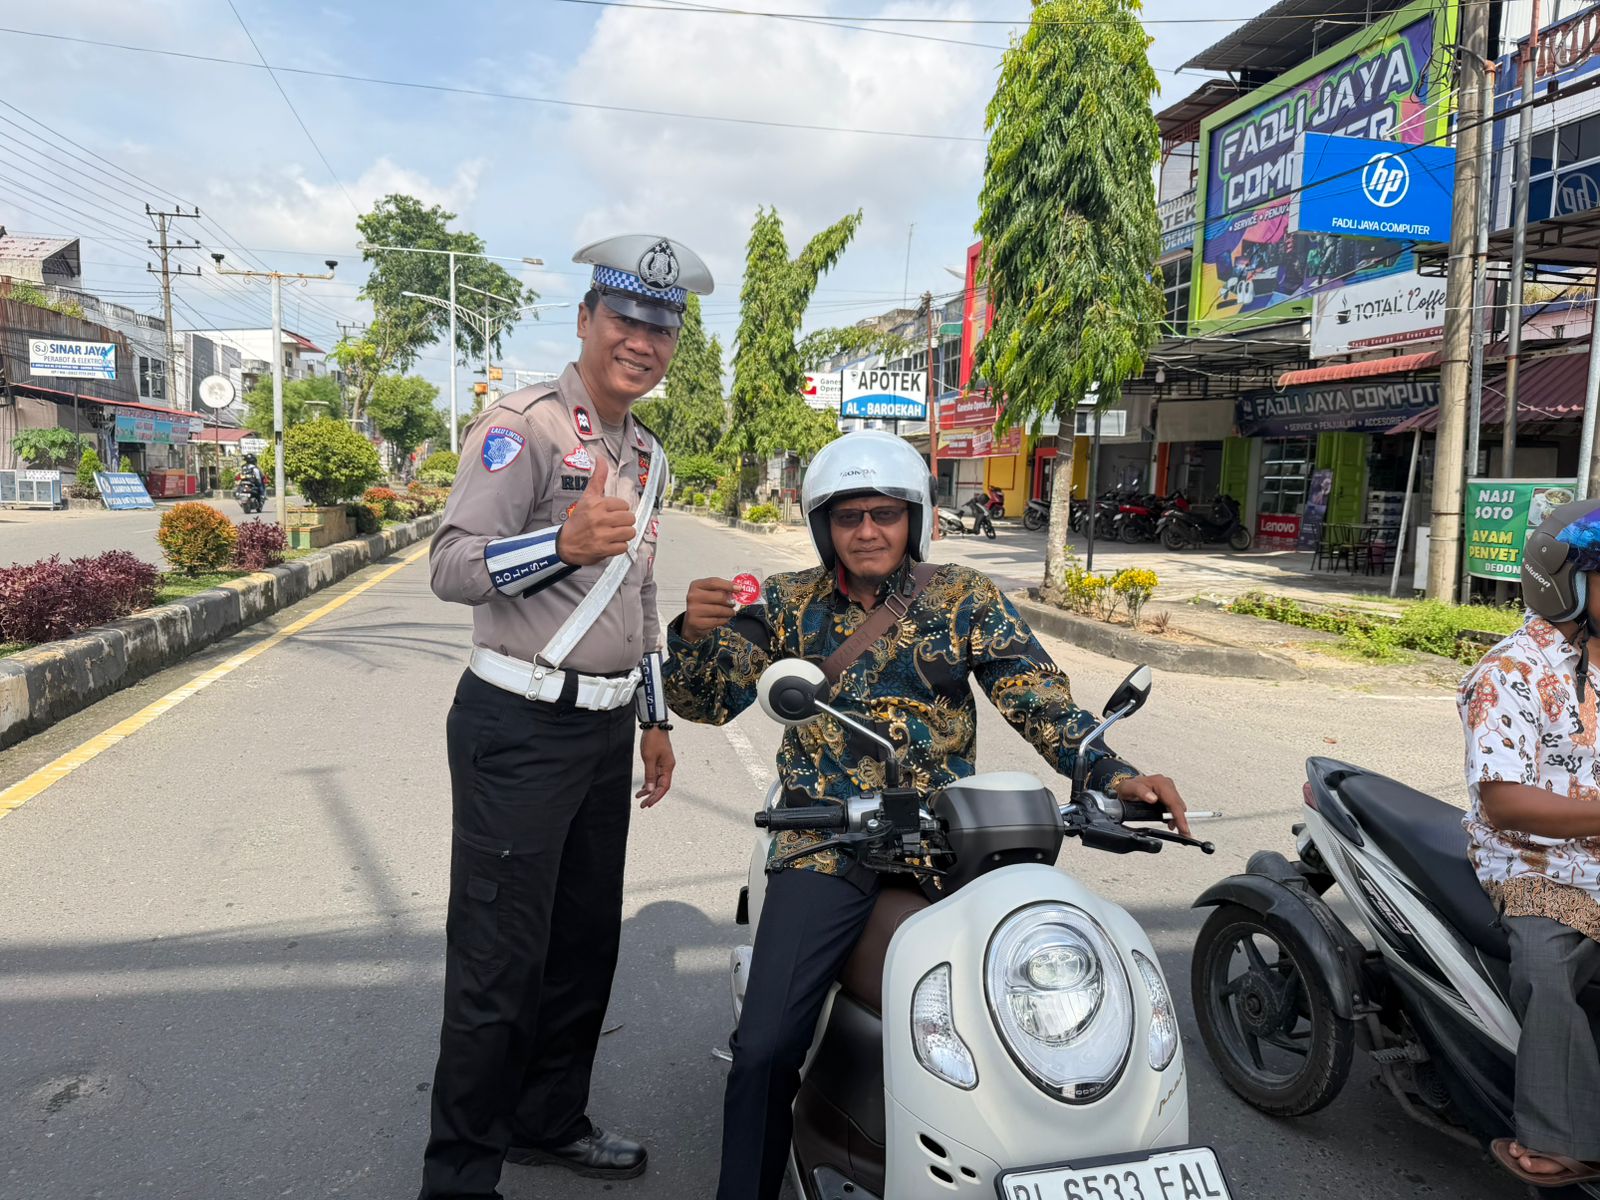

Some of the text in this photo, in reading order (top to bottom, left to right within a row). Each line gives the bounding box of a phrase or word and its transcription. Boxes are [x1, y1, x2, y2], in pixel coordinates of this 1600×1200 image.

[1224, 48, 1410, 168] FADLI JAYA
[1366, 155, 1405, 207] hp
[1233, 213, 1258, 232] SERVICE
[1331, 217, 1430, 235] FADLI JAYA COMPUTER
[1354, 296, 1402, 321] TOTAL
[34, 344, 47, 353] SJ
[49, 343, 108, 357] SINAR JAYA
[43, 355, 71, 364] PERABOT
[858, 371, 922, 392] APOTEK
[1256, 382, 1441, 417] FADLI JAYA COMPUT
[846, 402, 859, 415] AL
[867, 403, 922, 416] BAROEKAH
[1289, 422, 1313, 432] SERVICE
[1478, 489, 1515, 503] NASI
[1474, 506, 1514, 520] SOTO
[1260, 518, 1296, 533] Lenovo
[1471, 529, 1513, 544] AYAM
[1469, 546, 1520, 562] PENYET
[495, 560, 549, 585] POLISI
[641, 657, 654, 713] POLISI
[1154, 1161, 1221, 1200] FAL
